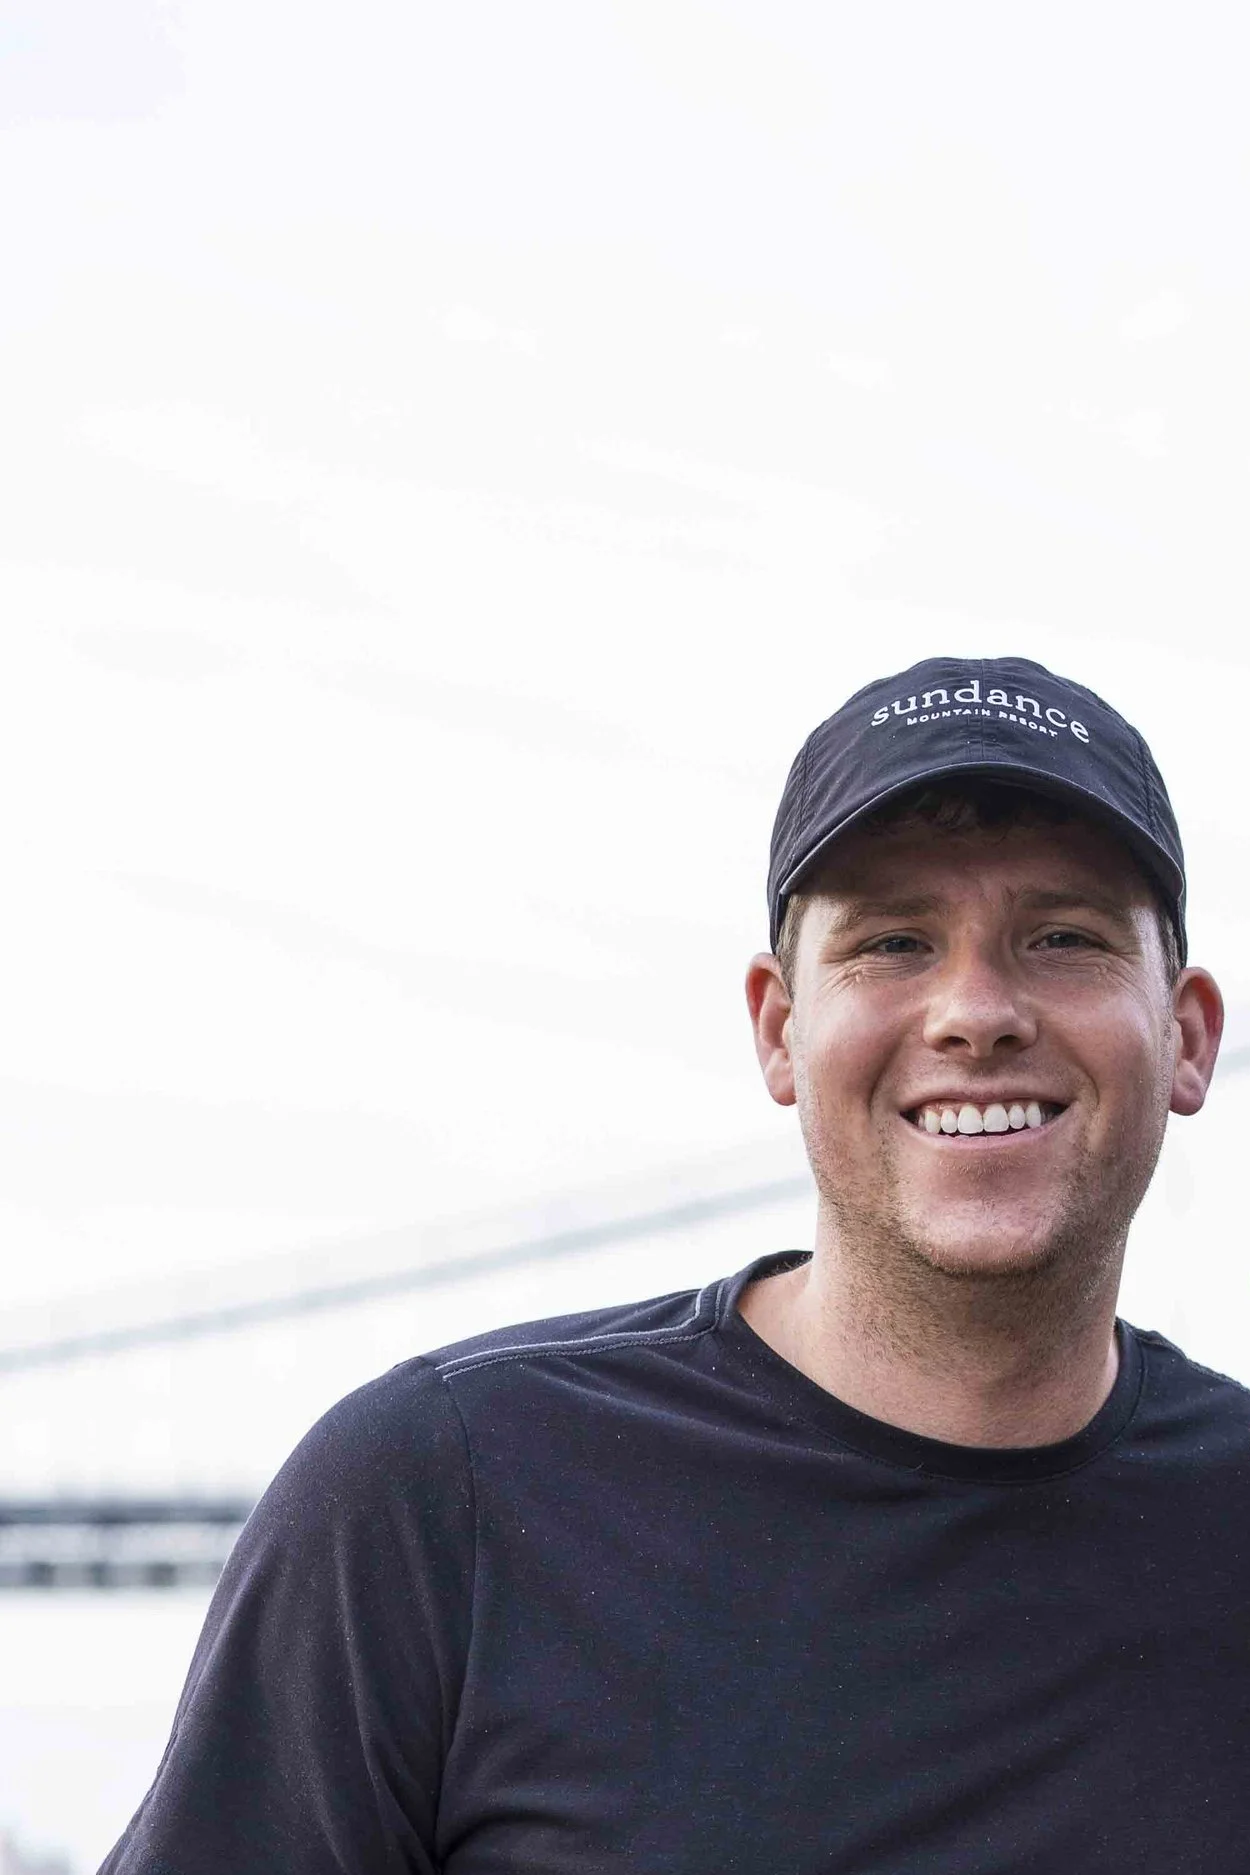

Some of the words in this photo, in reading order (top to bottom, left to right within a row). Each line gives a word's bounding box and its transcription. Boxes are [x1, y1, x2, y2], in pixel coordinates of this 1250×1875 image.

[871, 680, 1089, 743] sundance
[907, 709, 990, 725] MOUNTAIN
[999, 711, 1057, 737] RESORT
